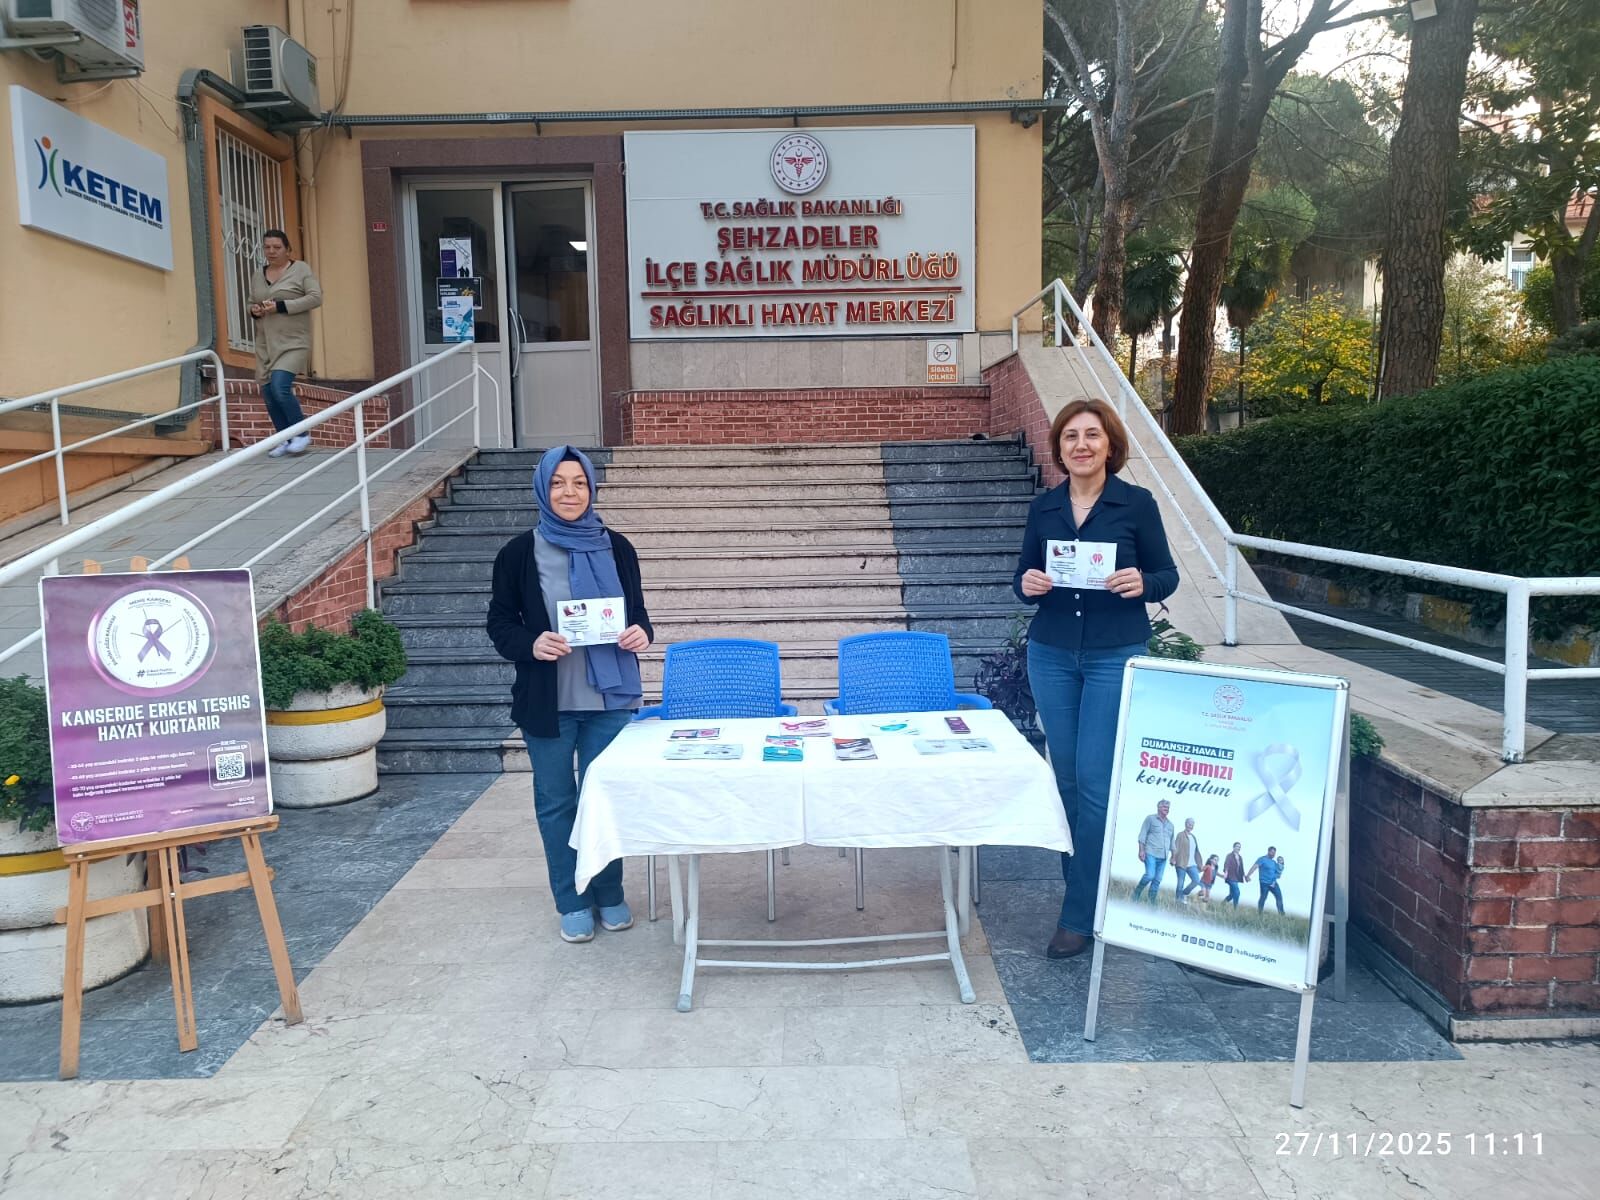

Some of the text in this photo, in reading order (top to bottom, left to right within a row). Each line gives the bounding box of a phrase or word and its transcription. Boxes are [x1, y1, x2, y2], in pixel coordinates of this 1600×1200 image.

[62, 159, 162, 223] KETEM
[732, 198, 796, 217] SAĞLIK
[801, 197, 902, 217] BAKANLIĞI
[717, 225, 879, 258] ŞEHZADELER
[645, 251, 960, 290] İLÇE SAĞLIK MÜDÜRLÜĞÜ
[650, 294, 957, 327] SAĞLIKLI HAYAT MERKEZİ
[61, 704, 145, 727] KANSERDE
[148, 699, 198, 719] ERKEN
[98, 715, 221, 742] HAYAT KURTARIR
[1142, 739, 1234, 760] DUMANSIZ HAVA İLE
[1139, 751, 1233, 780] Sağlığımızı
[1136, 769, 1231, 797] koruyalım
